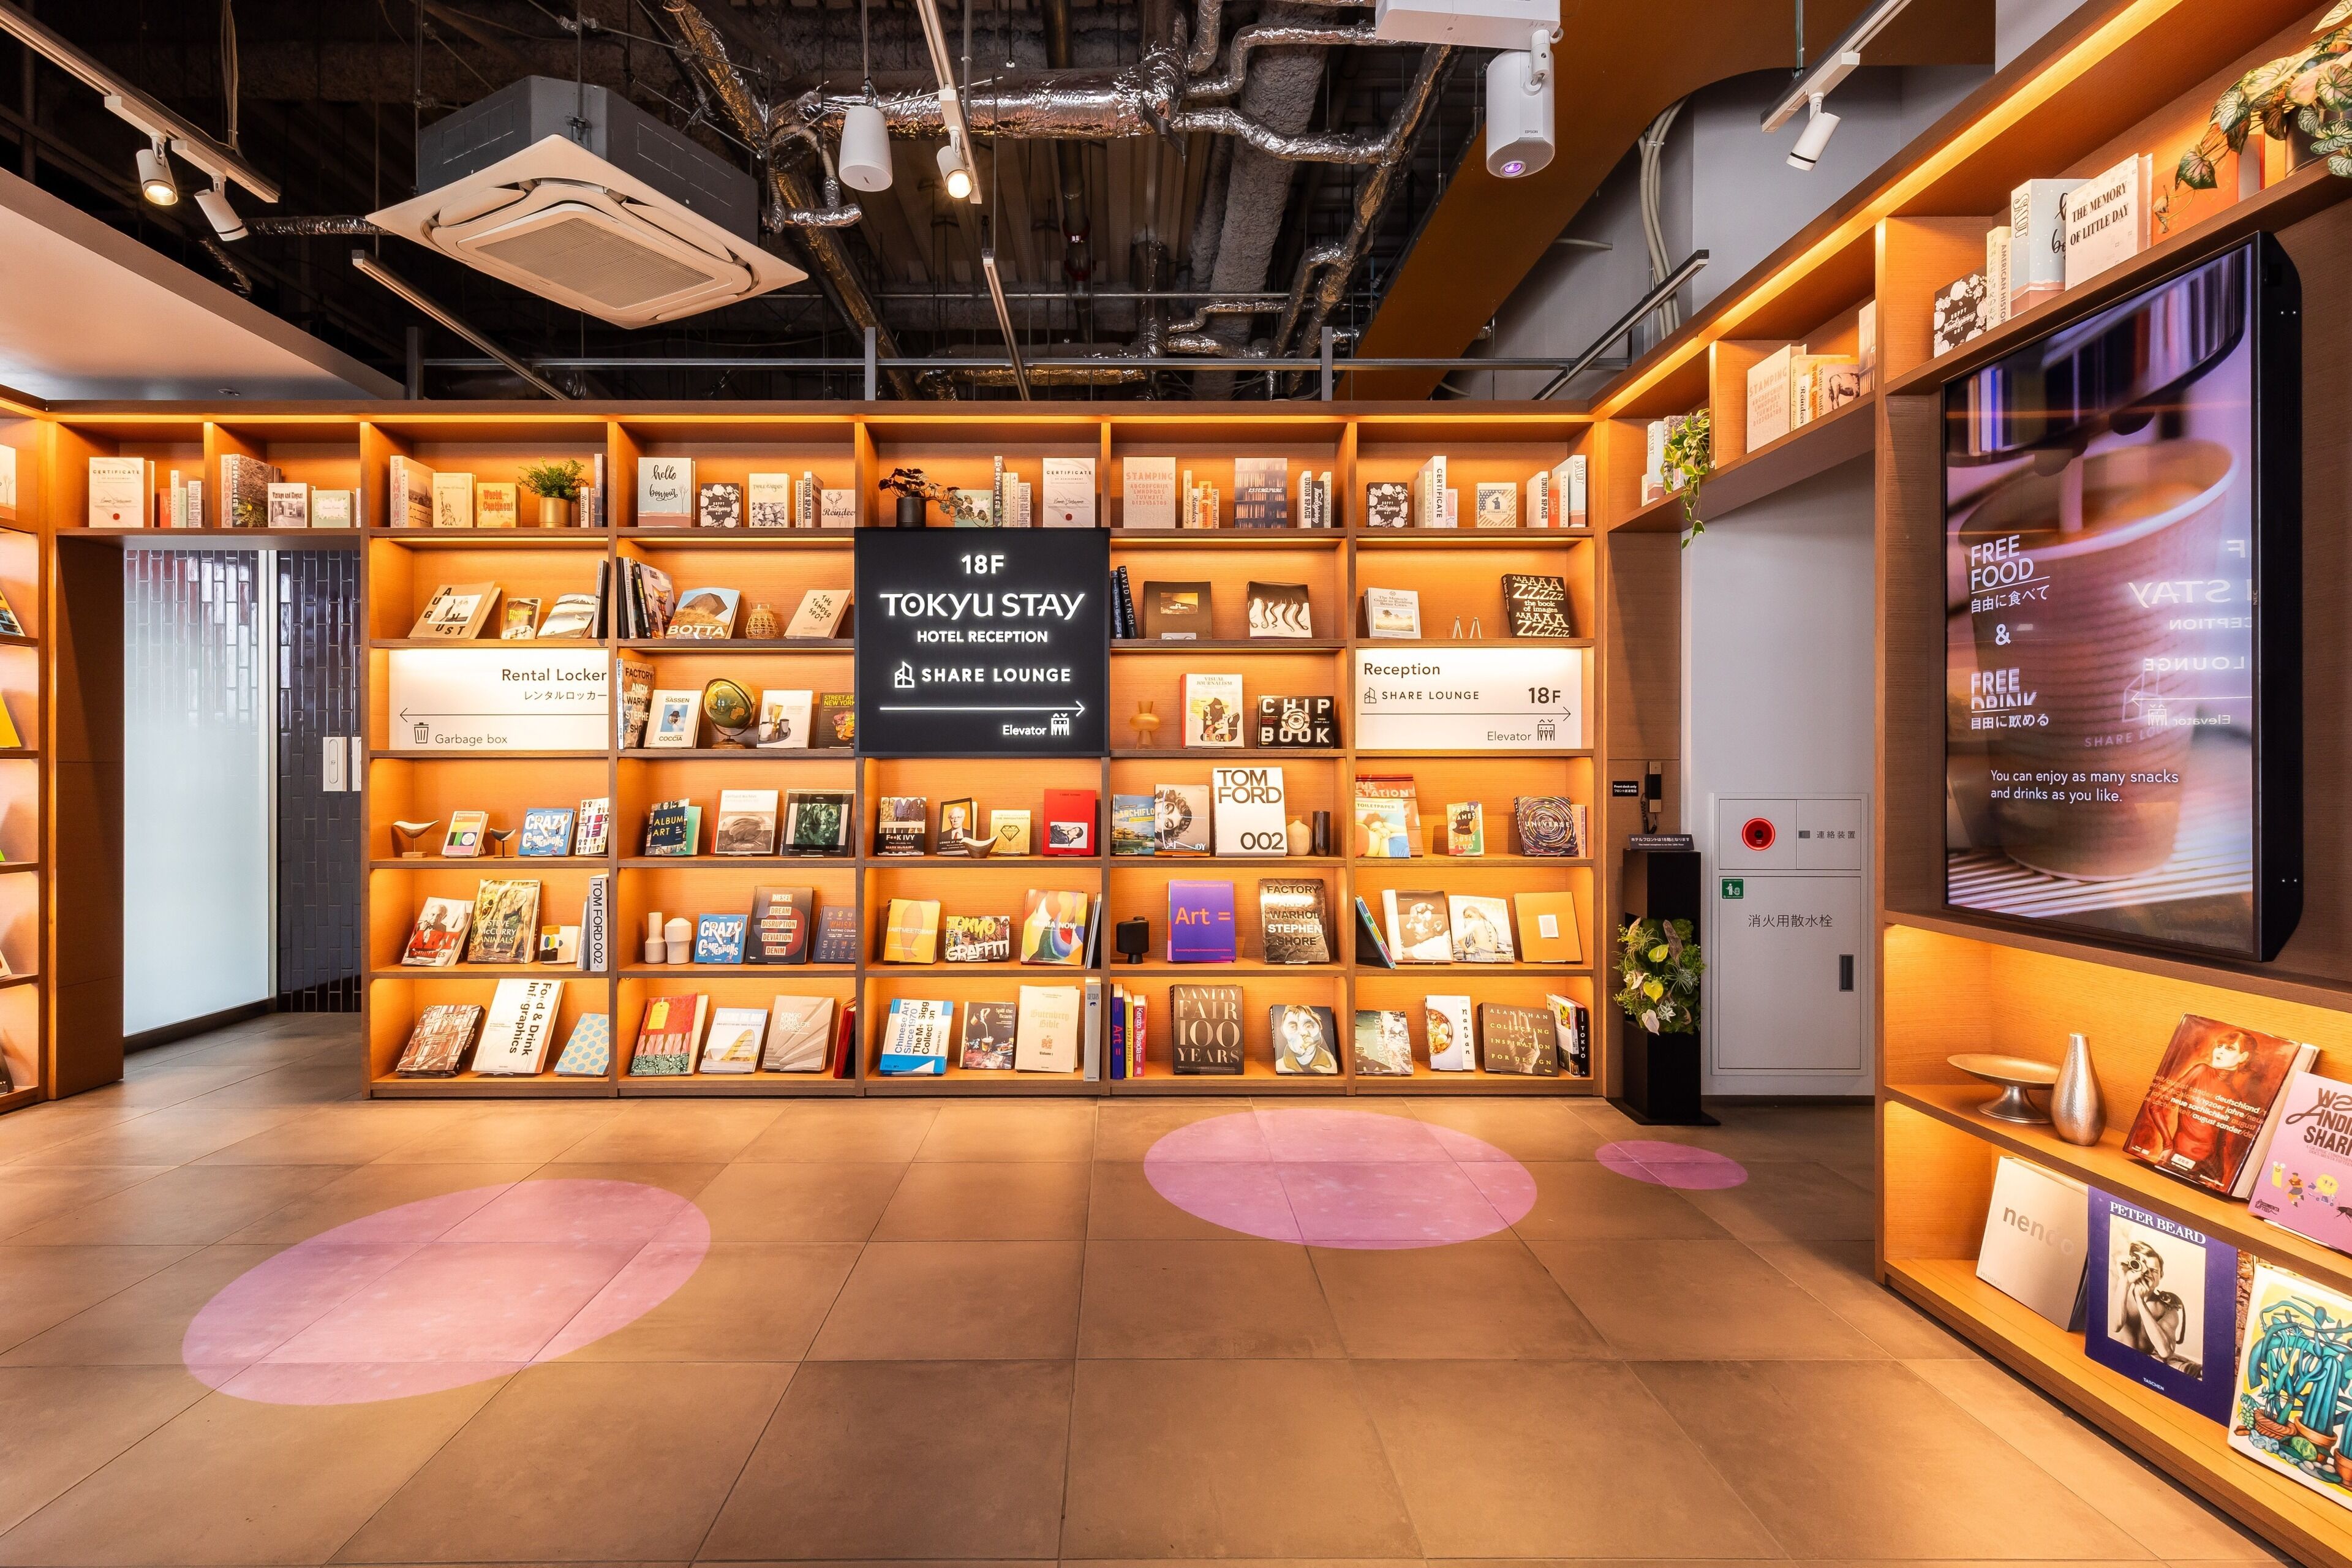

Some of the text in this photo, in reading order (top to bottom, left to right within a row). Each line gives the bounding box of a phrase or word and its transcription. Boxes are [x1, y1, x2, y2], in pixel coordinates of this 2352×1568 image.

[2071, 207, 2088, 223] THE
[2090, 181, 2127, 212] MEMORY
[2070, 232, 2082, 246] OF
[2082, 215, 2111, 240] LITTLE
[2111, 203, 2130, 224] DAY
[1749, 366, 1787, 397] STAMPING
[651, 465, 677, 480] hello
[483, 490, 502, 499] World
[649, 484, 679, 501] bonjour
[483, 501, 513, 511] Continent
[1971, 534, 2020, 567] FREE
[962, 554, 1005, 574] 18F
[1971, 557, 2034, 590] FOOD
[822, 595, 832, 606] THE
[1120, 567, 1134, 625] DAVID LYNCH
[1971, 585, 2050, 614] 自由に食べて
[812, 598, 831, 618] TENDER
[880, 593, 1085, 620] TOKYU STAY
[809, 608, 824, 622] SPOT
[667, 624, 725, 637] BOTTA
[918, 631, 1048, 643] HOTEL RECEPTION
[1995, 623, 2011, 646] &
[502, 669, 607, 681] Rental Locker
[625, 668, 653, 680] FACTORY
[922, 668, 1071, 682] SHARE LOUNGE
[1364, 663, 1440, 678] Reception
[631, 683, 648, 693] ANDY
[1971, 668, 2020, 694] FREE
[524, 691, 608, 701] レンタルロッカー
[1382, 691, 1479, 699] SHARE LOUNGE
[1528, 687, 1561, 704] 18F
[1262, 698, 1330, 714] CHIP
[1971, 714, 2049, 730] 自由に飲める
[1003, 725, 1047, 736] Elevator
[1261, 727, 1330, 744] BOOK
[1487, 731, 1532, 741] Elevator
[435, 734, 507, 747] Garbage box
[2084, 732, 2133, 748] SHARE
[1217, 769, 1267, 786] TOM
[1991, 769, 2179, 786] You can enjoy as many snacks
[1218, 787, 1282, 804] FORD
[1355, 789, 1409, 797] STATION
[1991, 788, 2123, 804] and drinks as you like.
[525, 814, 570, 837] CRAZY
[654, 815, 684, 826] ALBUM
[653, 827, 669, 837] ART
[1817, 831, 1856, 839] 連絡装置
[1240, 832, 1284, 850] 002
[1267, 885, 1319, 894] FACTORY
[592, 881, 603, 964] TOM FORD 002
[1175, 907, 1210, 925] Art
[1270, 910, 1320, 920] WARHOL
[1748, 914, 1833, 928] 消火用散水栓
[700, 920, 744, 944] CRAZY
[761, 920, 796, 929] DISRUPTION
[1267, 924, 1322, 934] STEPHEN
[410, 930, 459, 950] ART
[763, 933, 793, 942] DEVIATION
[1275, 937, 1317, 946] SHORE
[1178, 987, 1238, 1000] VANITY
[1179, 1000, 1240, 1020] FAIR
[904, 1008, 918, 1054] Since 1970
[913, 1001, 930, 1055] The Sigg
[1113, 1025, 1123, 1044] Art
[521, 1025, 539, 1056] Drink
[895, 1021, 906, 1054] Chinese
[1177, 1047, 1240, 1063] YEARS
[2109, 1200, 2206, 1245] PETER BEARD
[2143, 1378, 2165, 1391] TASCHEN
